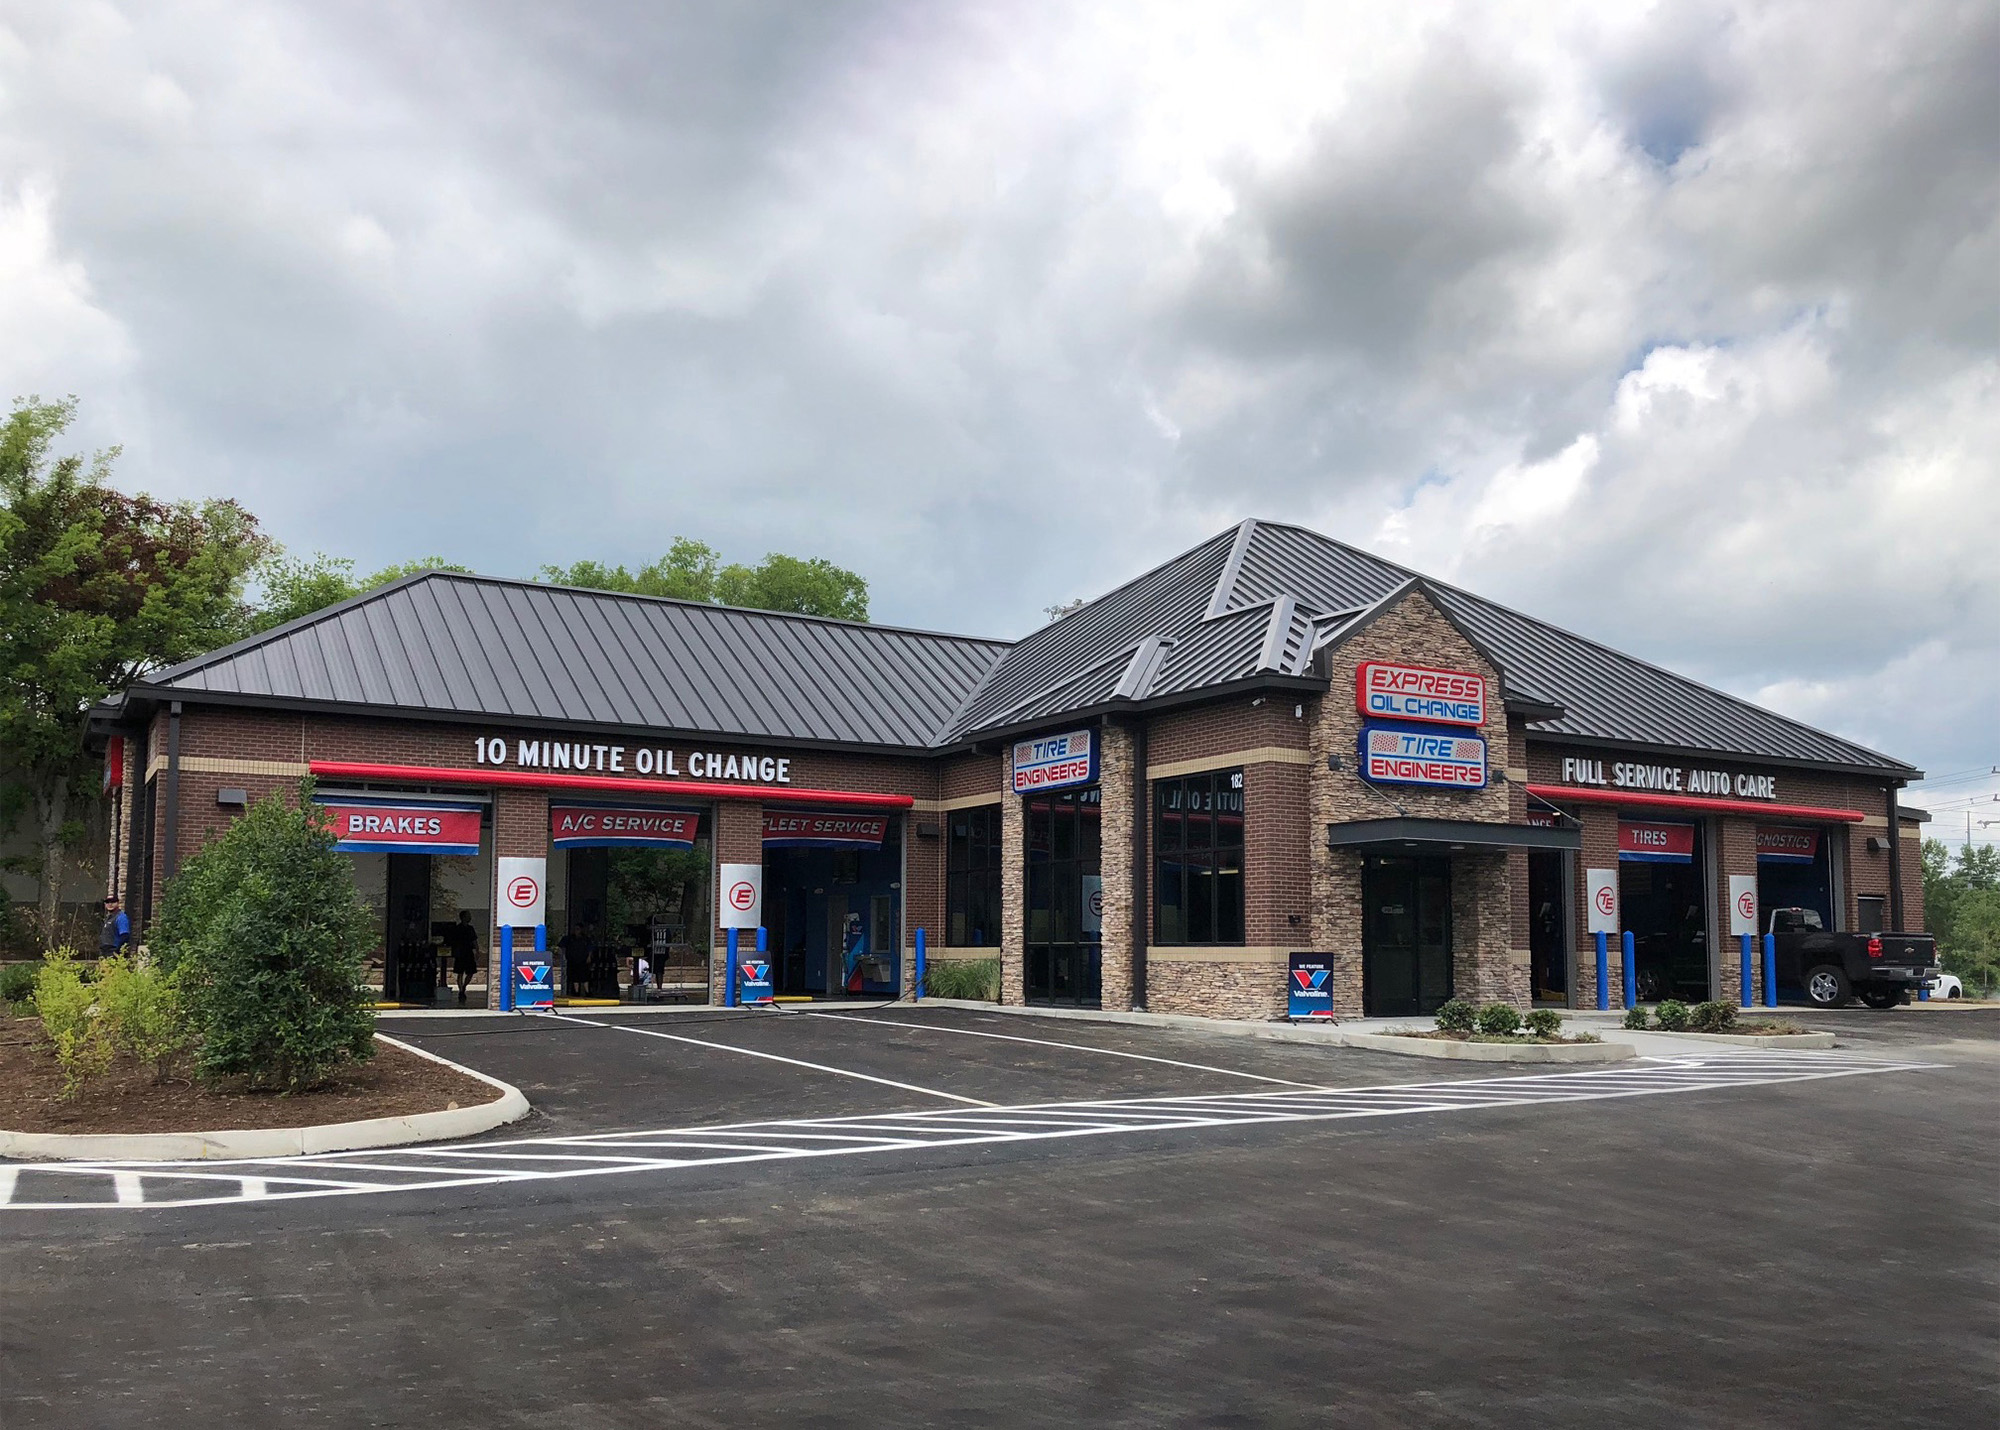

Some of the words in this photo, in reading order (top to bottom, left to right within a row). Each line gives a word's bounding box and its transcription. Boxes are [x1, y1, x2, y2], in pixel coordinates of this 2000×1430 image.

[1371, 669, 1480, 698] EXPRESS
[1371, 694, 1401, 712] OIL
[1405, 698, 1480, 720] CHANGE
[1033, 738, 1068, 760] TIRE
[1402, 736, 1453, 757] TIRE
[474, 737, 507, 765] 10
[517, 739, 625, 772] MINUTE
[635, 748, 680, 776] OIL
[687, 751, 791, 783] CHANGE
[1016, 760, 1088, 787] ENGINEERS
[1230, 773, 1243, 789] 182
[1371, 759, 1481, 783] ENGINEERS
[1563, 758, 1607, 785] FULL
[1612, 762, 1682, 791] SERVICE
[1687, 769, 1730, 795] AUTO
[1734, 774, 1776, 799] CARE
[348, 815, 442, 836] BRAKES
[560, 813, 596, 832] A/C
[602, 816, 686, 833] SERVICE
[762, 817, 811, 831] FLEET
[812, 819, 881, 835] SERVICE
[1632, 829, 1667, 846] TIRES
[1756, 832, 1811, 849] GNOSTICS
[514, 884, 533, 900] E
[735, 889, 752, 904] E
[1293, 990, 1330, 998] Valvoline
